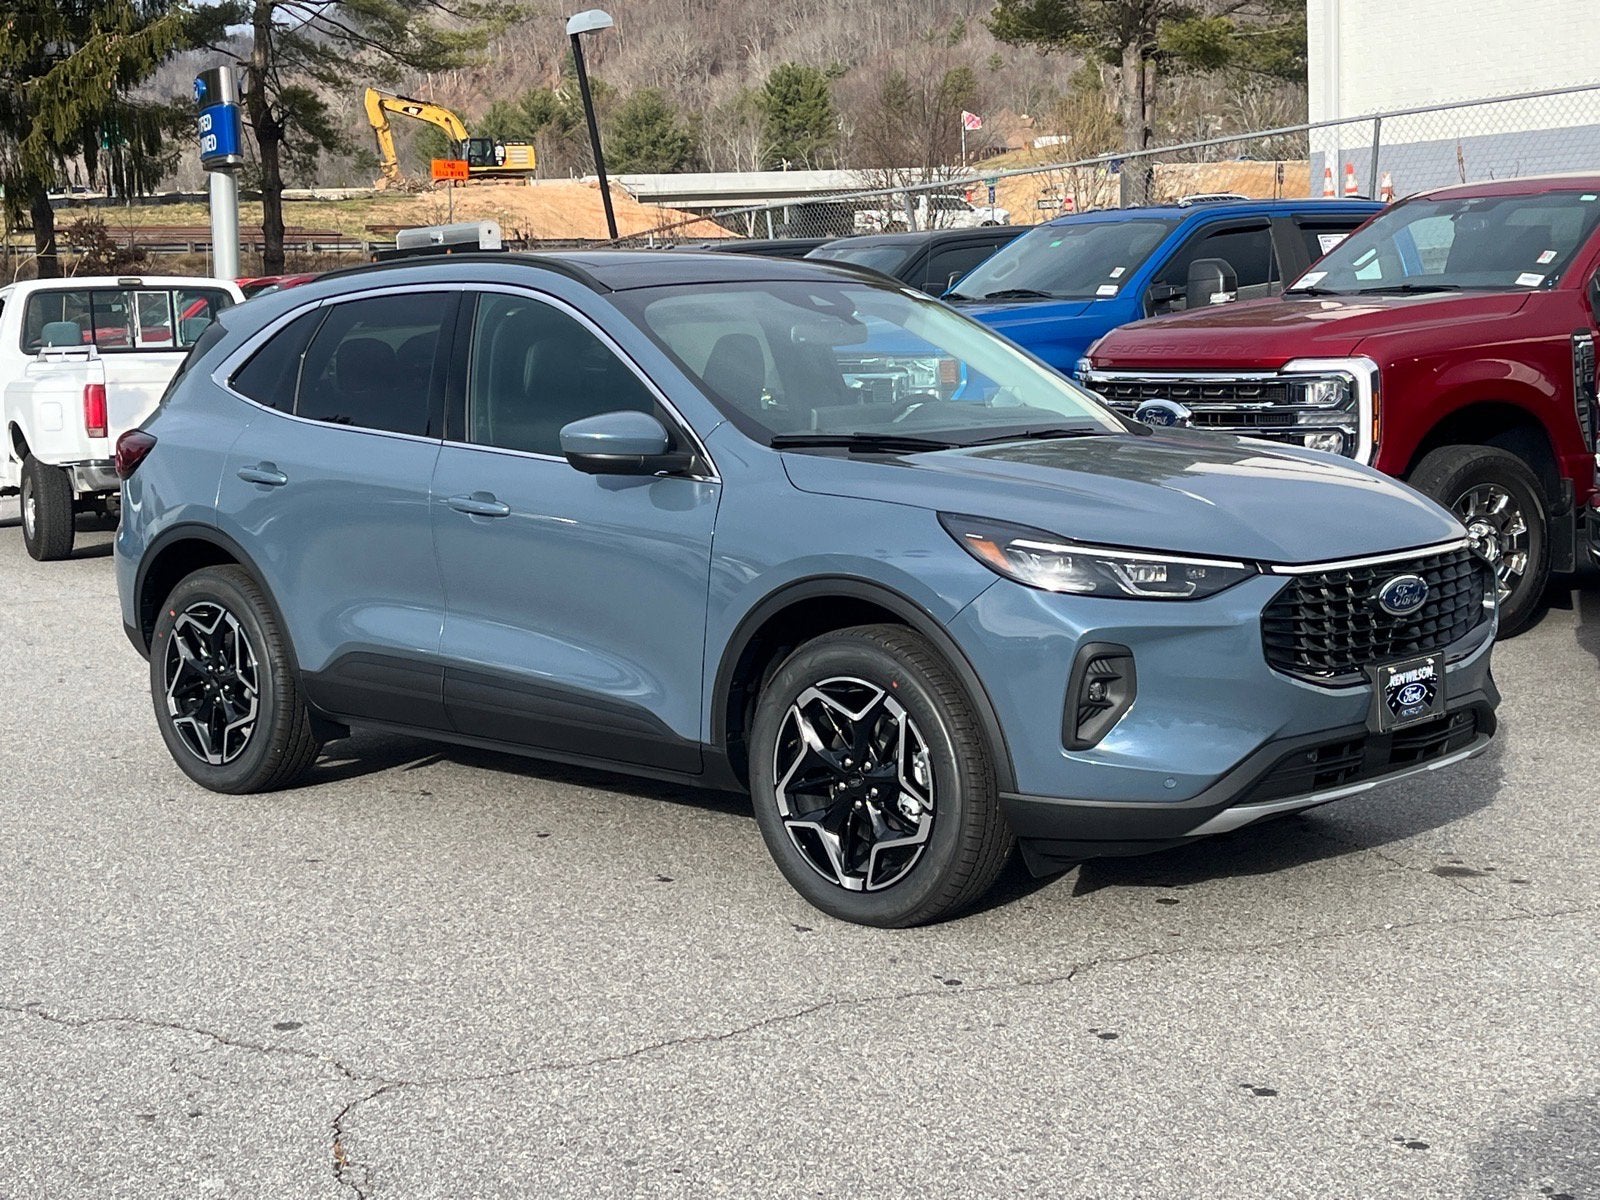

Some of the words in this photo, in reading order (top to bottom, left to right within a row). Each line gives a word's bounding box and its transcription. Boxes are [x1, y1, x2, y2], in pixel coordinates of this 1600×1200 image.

[1107, 344, 1177, 356] SUPER
[1181, 344, 1253, 356] DUTY
[1142, 409, 1168, 426] Ford
[1392, 583, 1422, 607] Ford
[1389, 672, 1405, 687] KEN
[1404, 665, 1434, 683] WILSON
[1402, 686, 1422, 703] Ford
